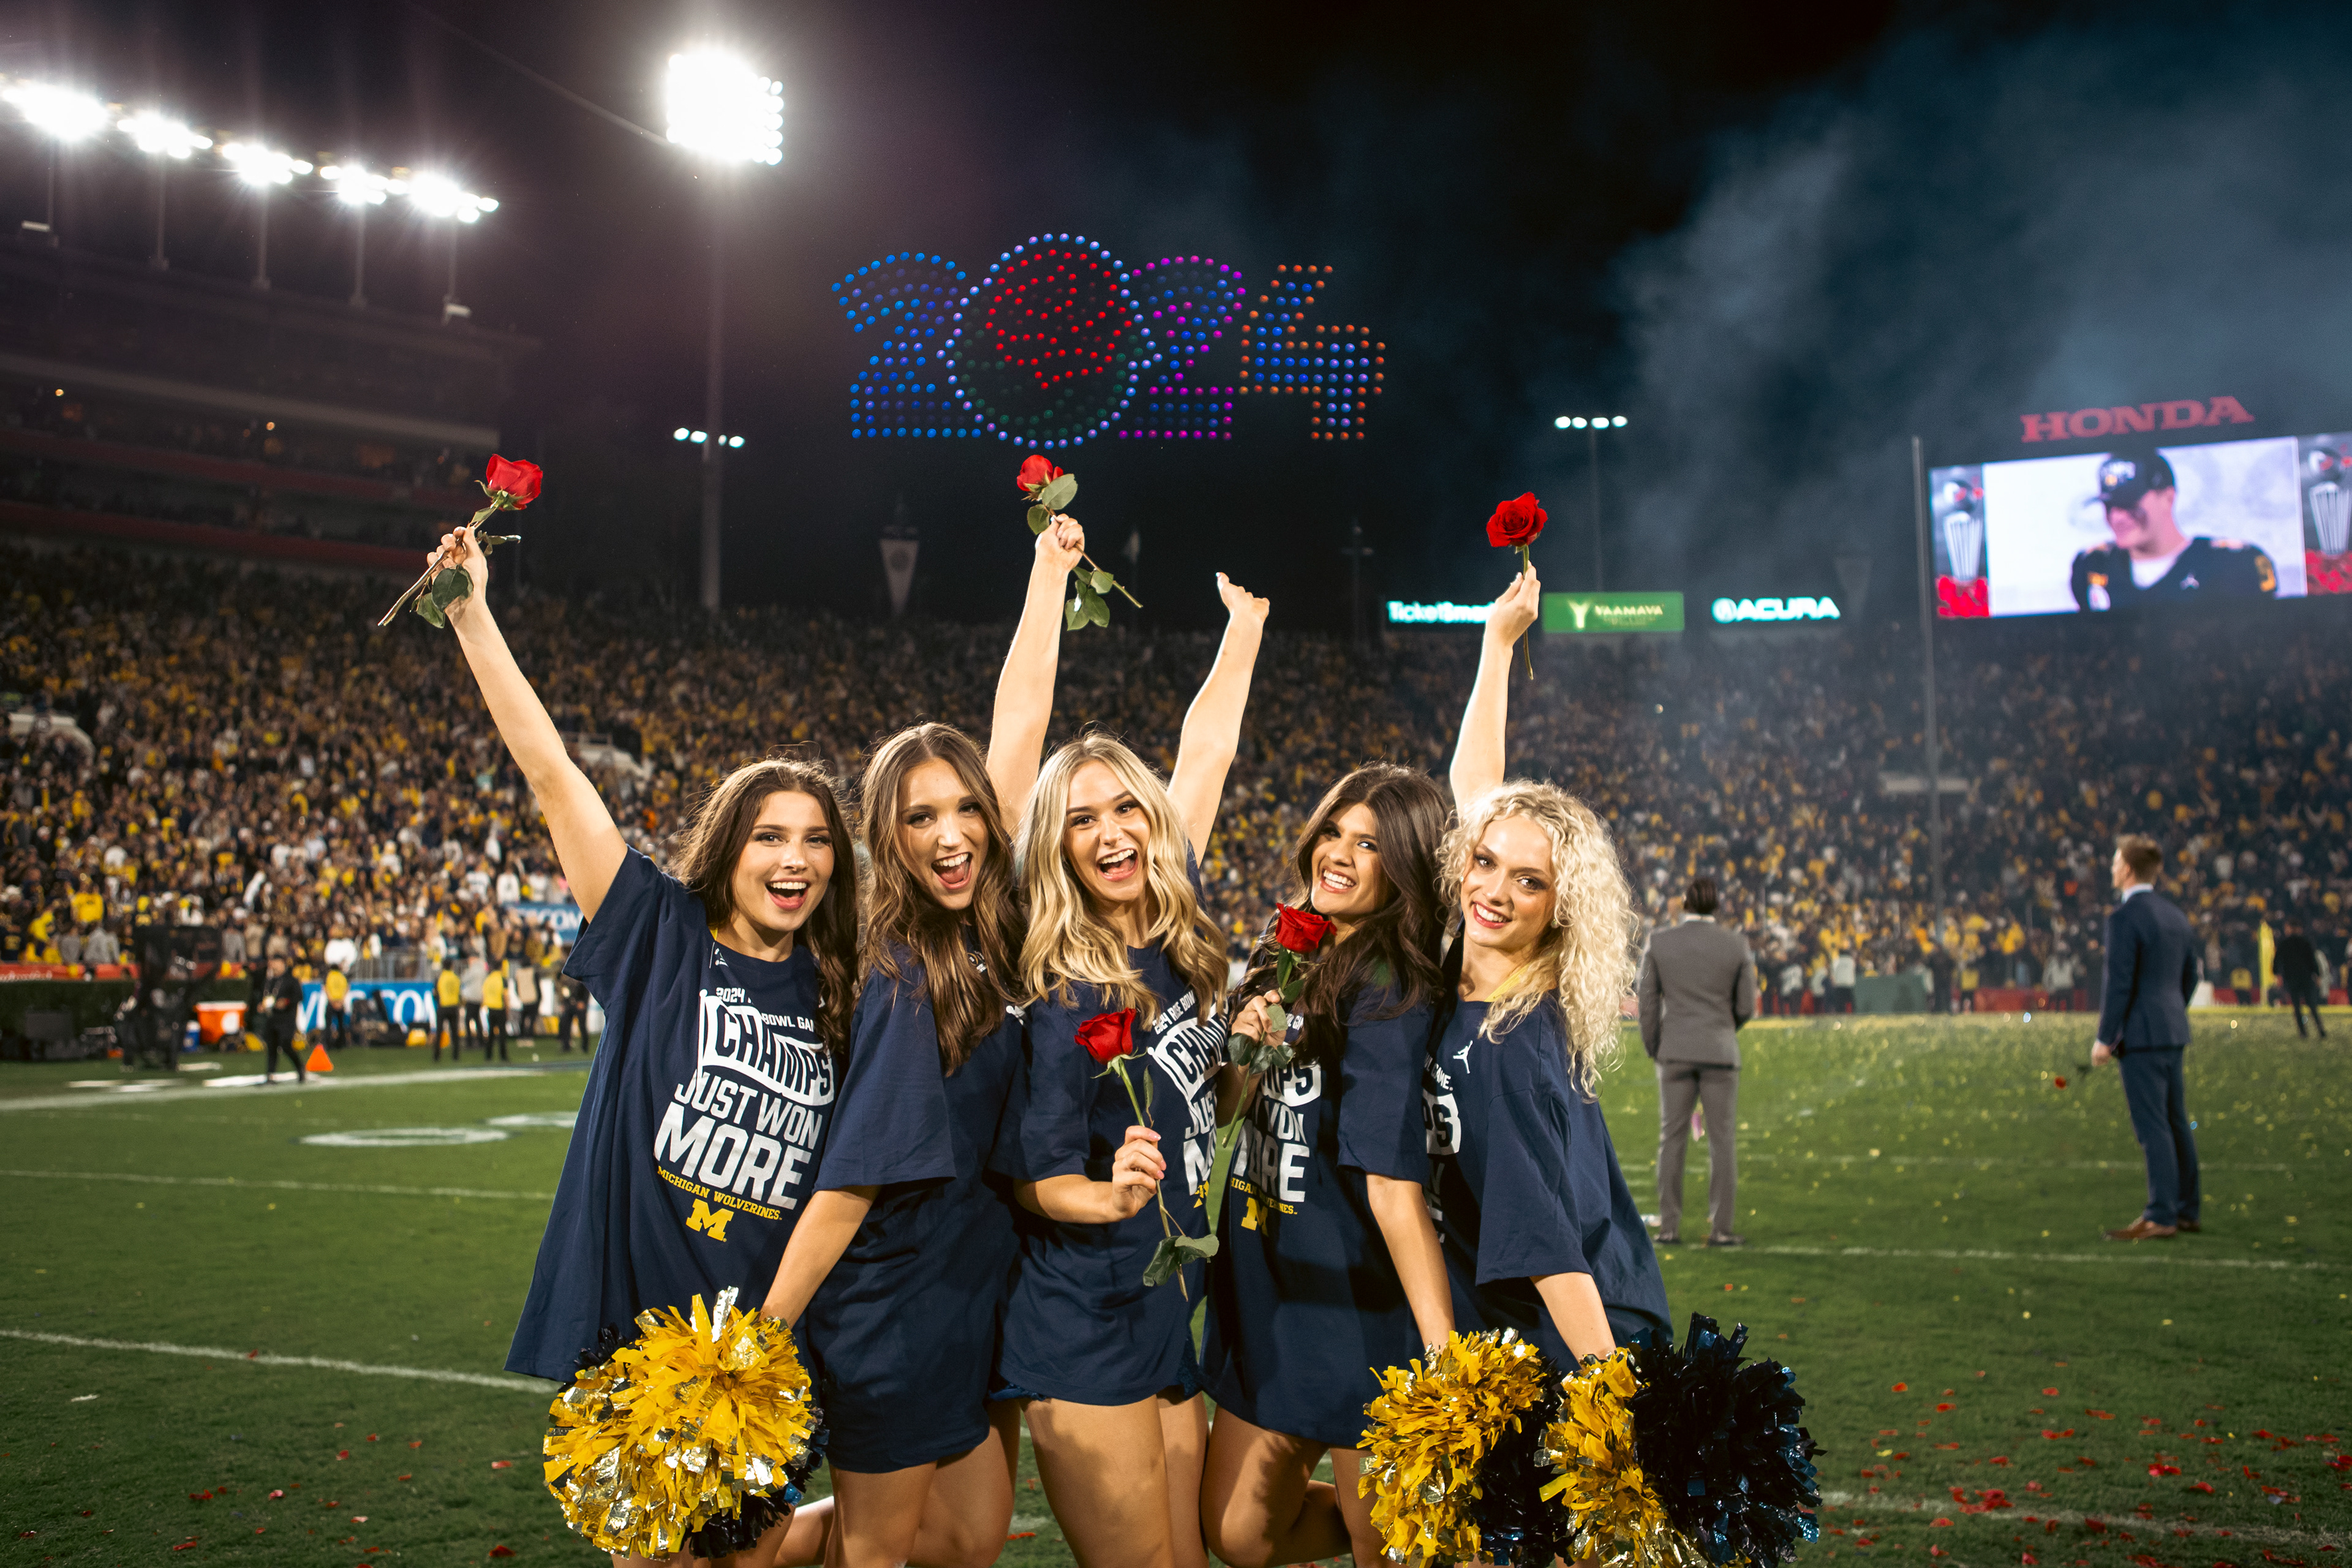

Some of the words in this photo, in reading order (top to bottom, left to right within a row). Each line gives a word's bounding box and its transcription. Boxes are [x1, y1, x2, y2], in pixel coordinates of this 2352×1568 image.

[832, 233, 1385, 449] 2024
[2021, 396, 2255, 443] HONDA
[1736, 597, 1840, 621] ACURA
[716, 987, 745, 1003] 2024
[1180, 990, 1195, 1012] BOW
[761, 1012, 796, 1028] BOWL
[714, 1005, 832, 1099] CHAMPS
[674, 1069, 758, 1125] JUST
[755, 1093, 823, 1150] WON
[654, 1101, 812, 1210] MORE
[657, 1165, 710, 1199] MICHIGAN
[686, 1198, 734, 1242] M
